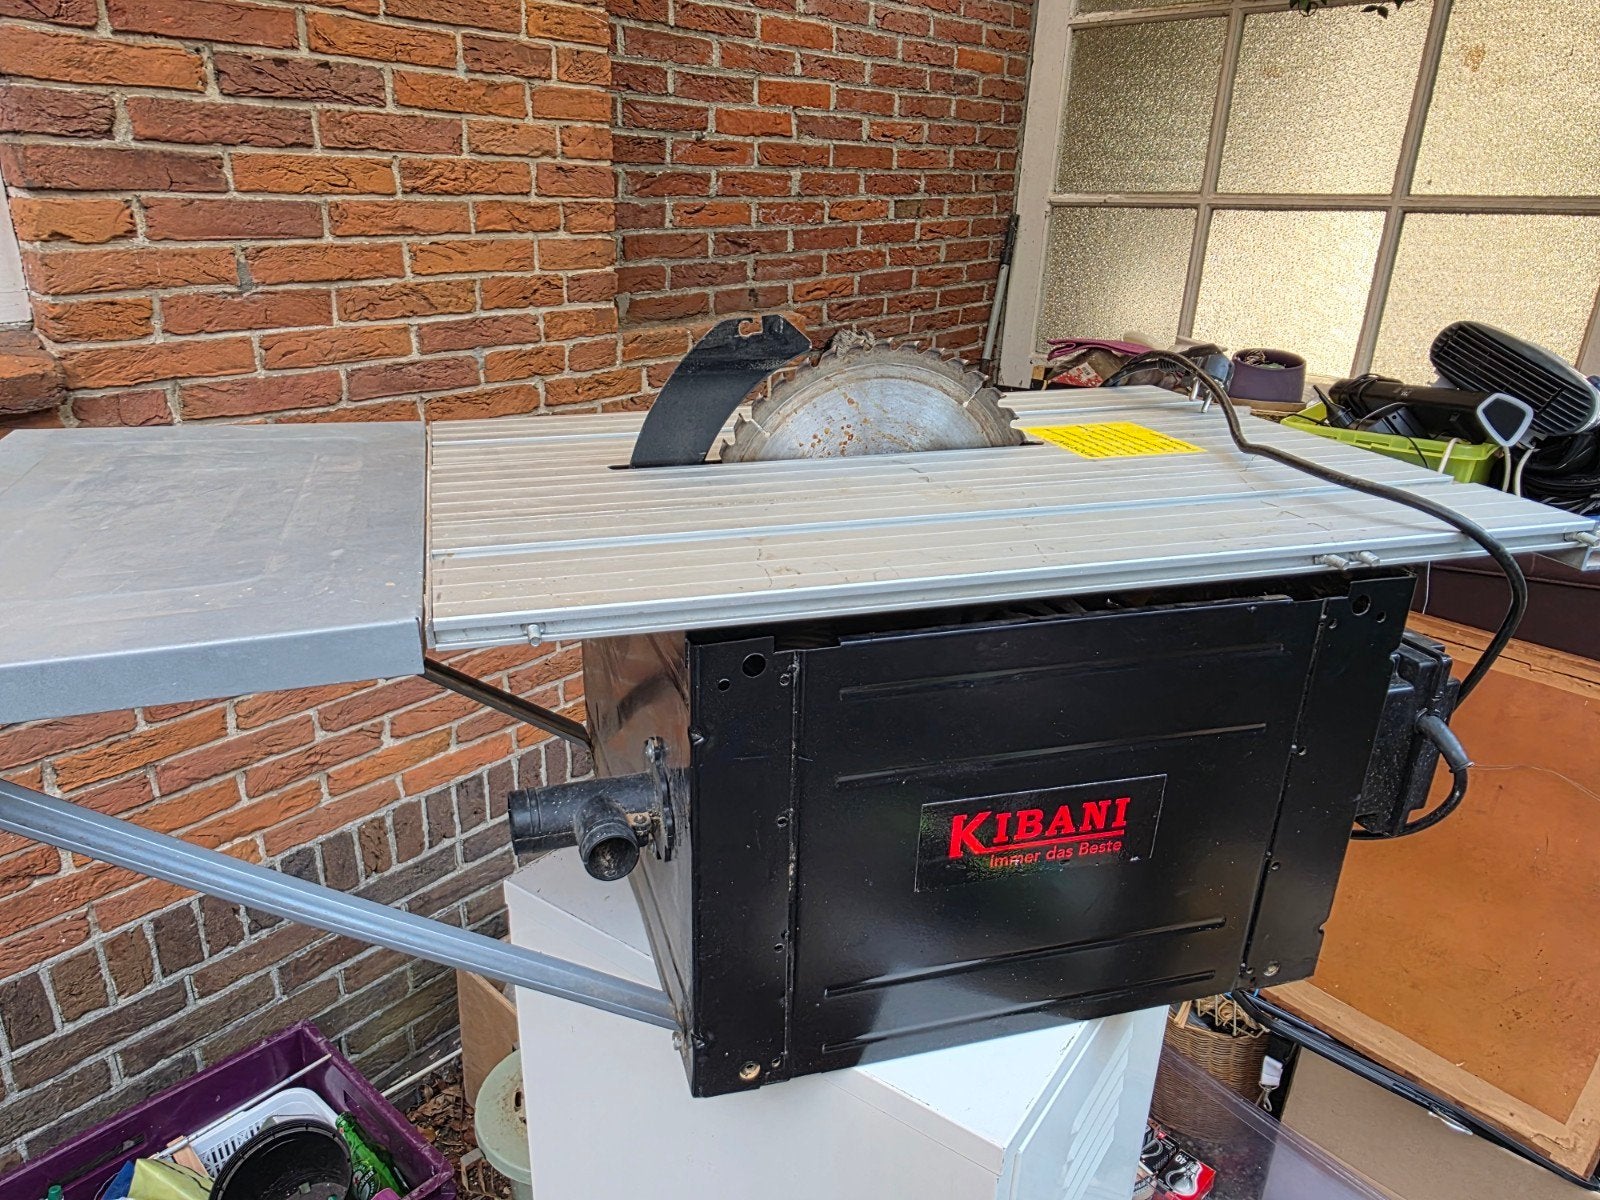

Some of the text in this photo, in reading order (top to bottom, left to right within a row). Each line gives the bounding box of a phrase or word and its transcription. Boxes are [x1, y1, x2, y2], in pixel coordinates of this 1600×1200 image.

[949, 797, 1131, 859] KIBANI
[1045, 845, 1073, 861] das
[1078, 840, 1122, 856] Beste
[1175, 1154, 1187, 1165] 40
